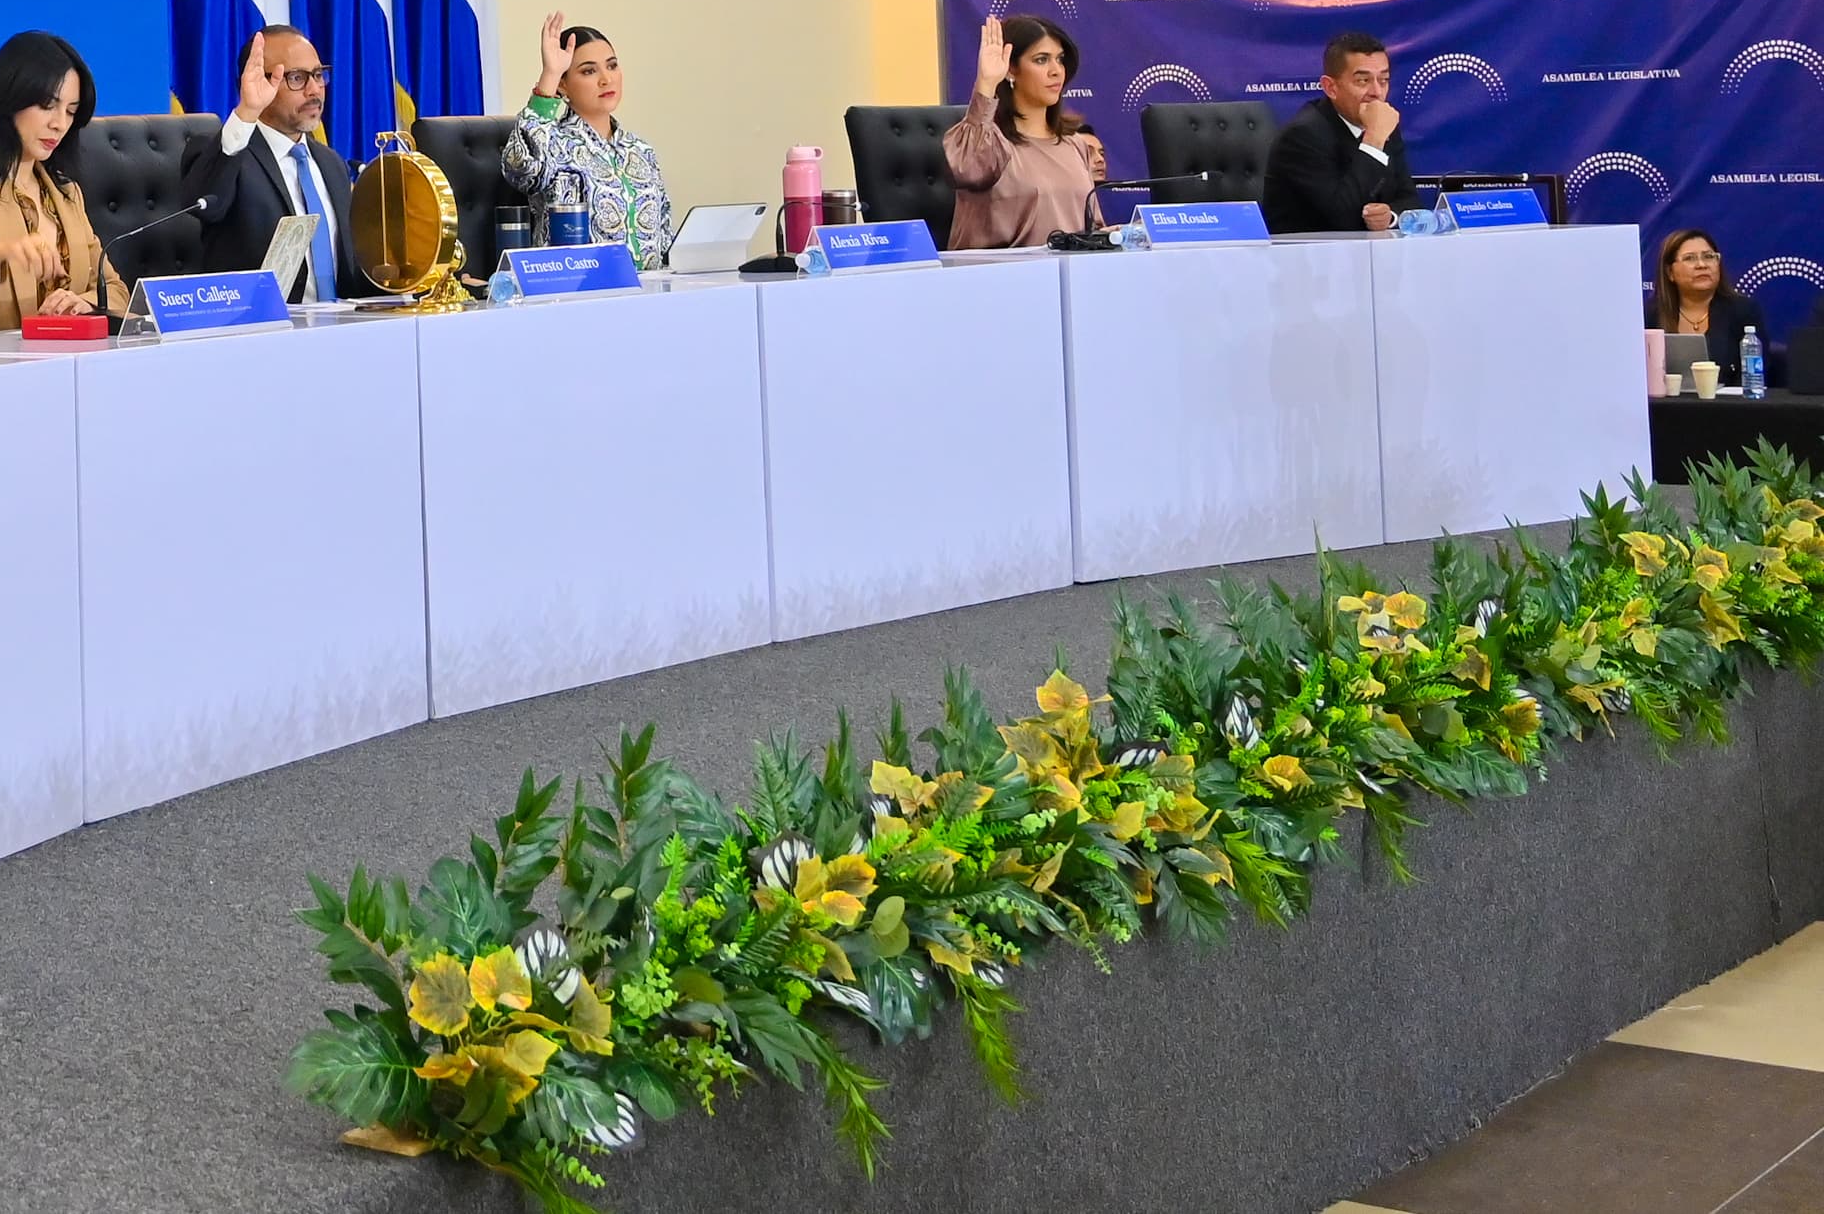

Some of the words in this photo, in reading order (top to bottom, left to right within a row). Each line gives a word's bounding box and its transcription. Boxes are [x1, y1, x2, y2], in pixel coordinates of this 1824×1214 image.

[1542, 71, 1605, 83] ASAMBLEA
[1607, 69, 1681, 81] LEGISLATIVA
[1245, 82, 1303, 93] ASAMBLEA
[1709, 174, 1776, 184] ASAMBLEA
[1779, 173, 1824, 183] LEGISL
[1151, 213, 1177, 225] Elisa
[1178, 212, 1219, 224] Rosales
[830, 234, 861, 249] Alexia
[861, 233, 890, 246] Rivas
[520, 259, 563, 274] Ernesto
[565, 257, 600, 270] Castro
[158, 290, 194, 308] Suecy
[196, 285, 240, 305] Callejas
